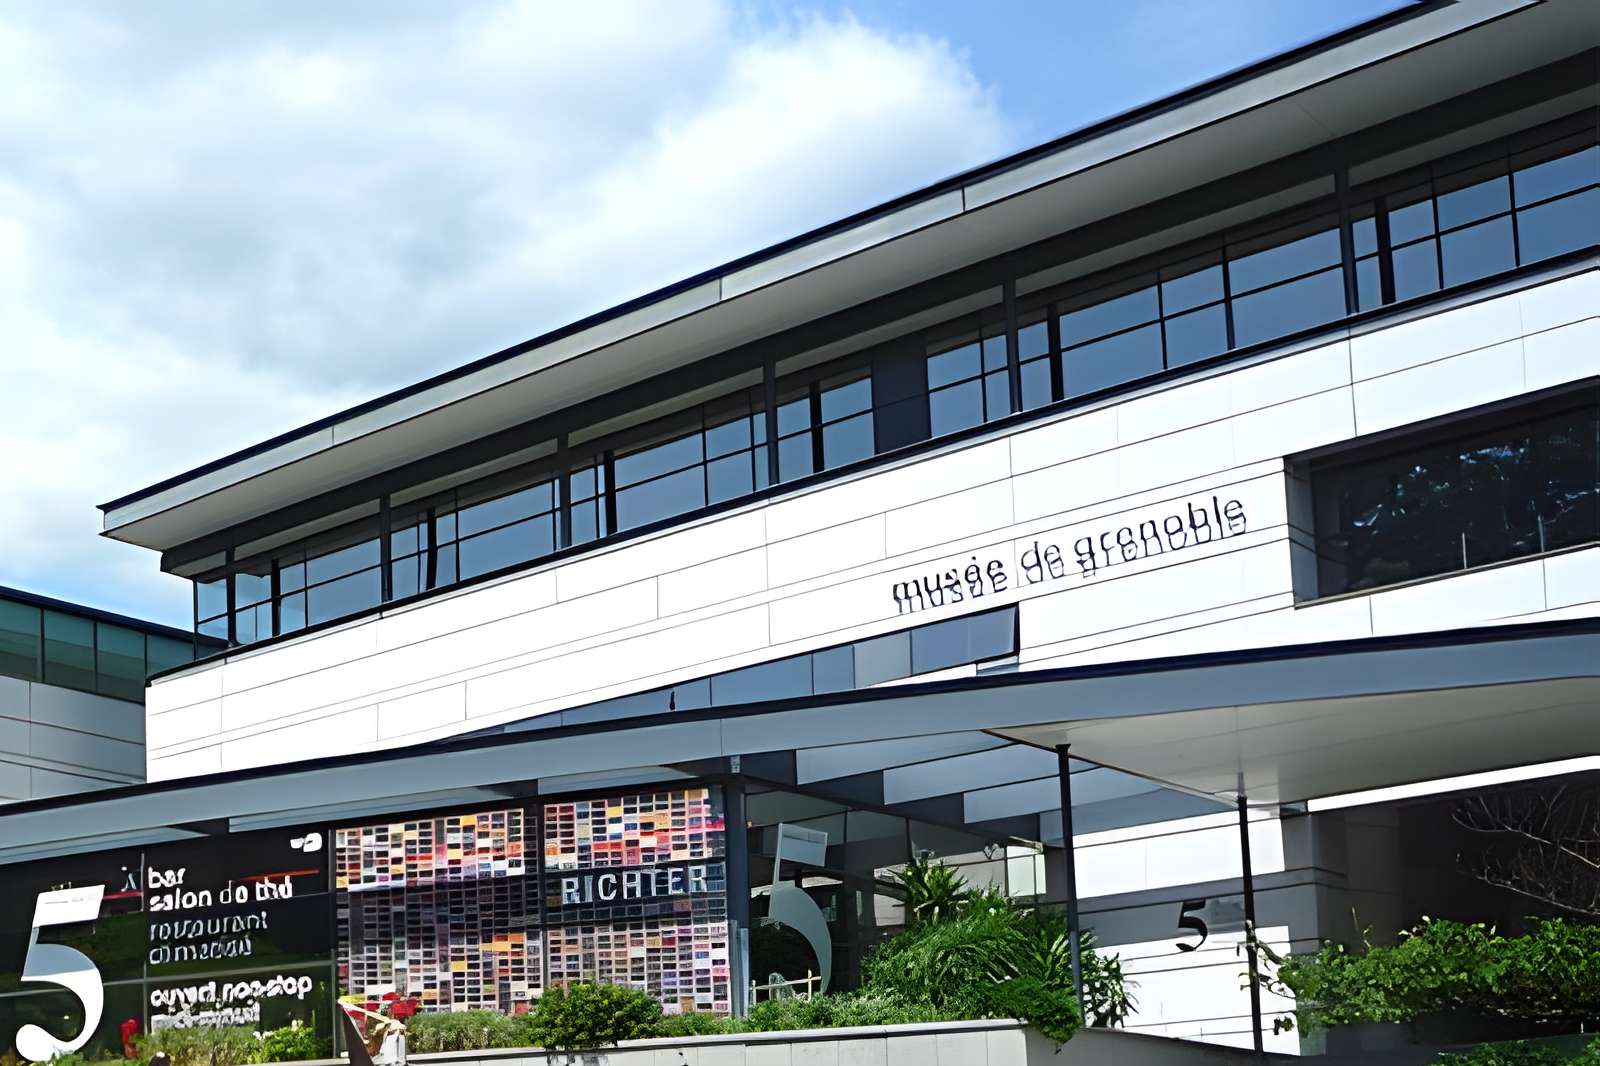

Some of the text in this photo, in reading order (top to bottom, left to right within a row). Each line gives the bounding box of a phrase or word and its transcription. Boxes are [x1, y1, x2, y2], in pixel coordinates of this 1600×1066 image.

[1020, 541, 1064, 576] de
[1073, 496, 1247, 573] grenoble
[148, 867, 186, 889] bar
[150, 888, 213, 912] salon
[561, 866, 707, 905] RICHTER
[1176, 899, 1208, 952] 5
[15, 884, 105, 1062] 5
